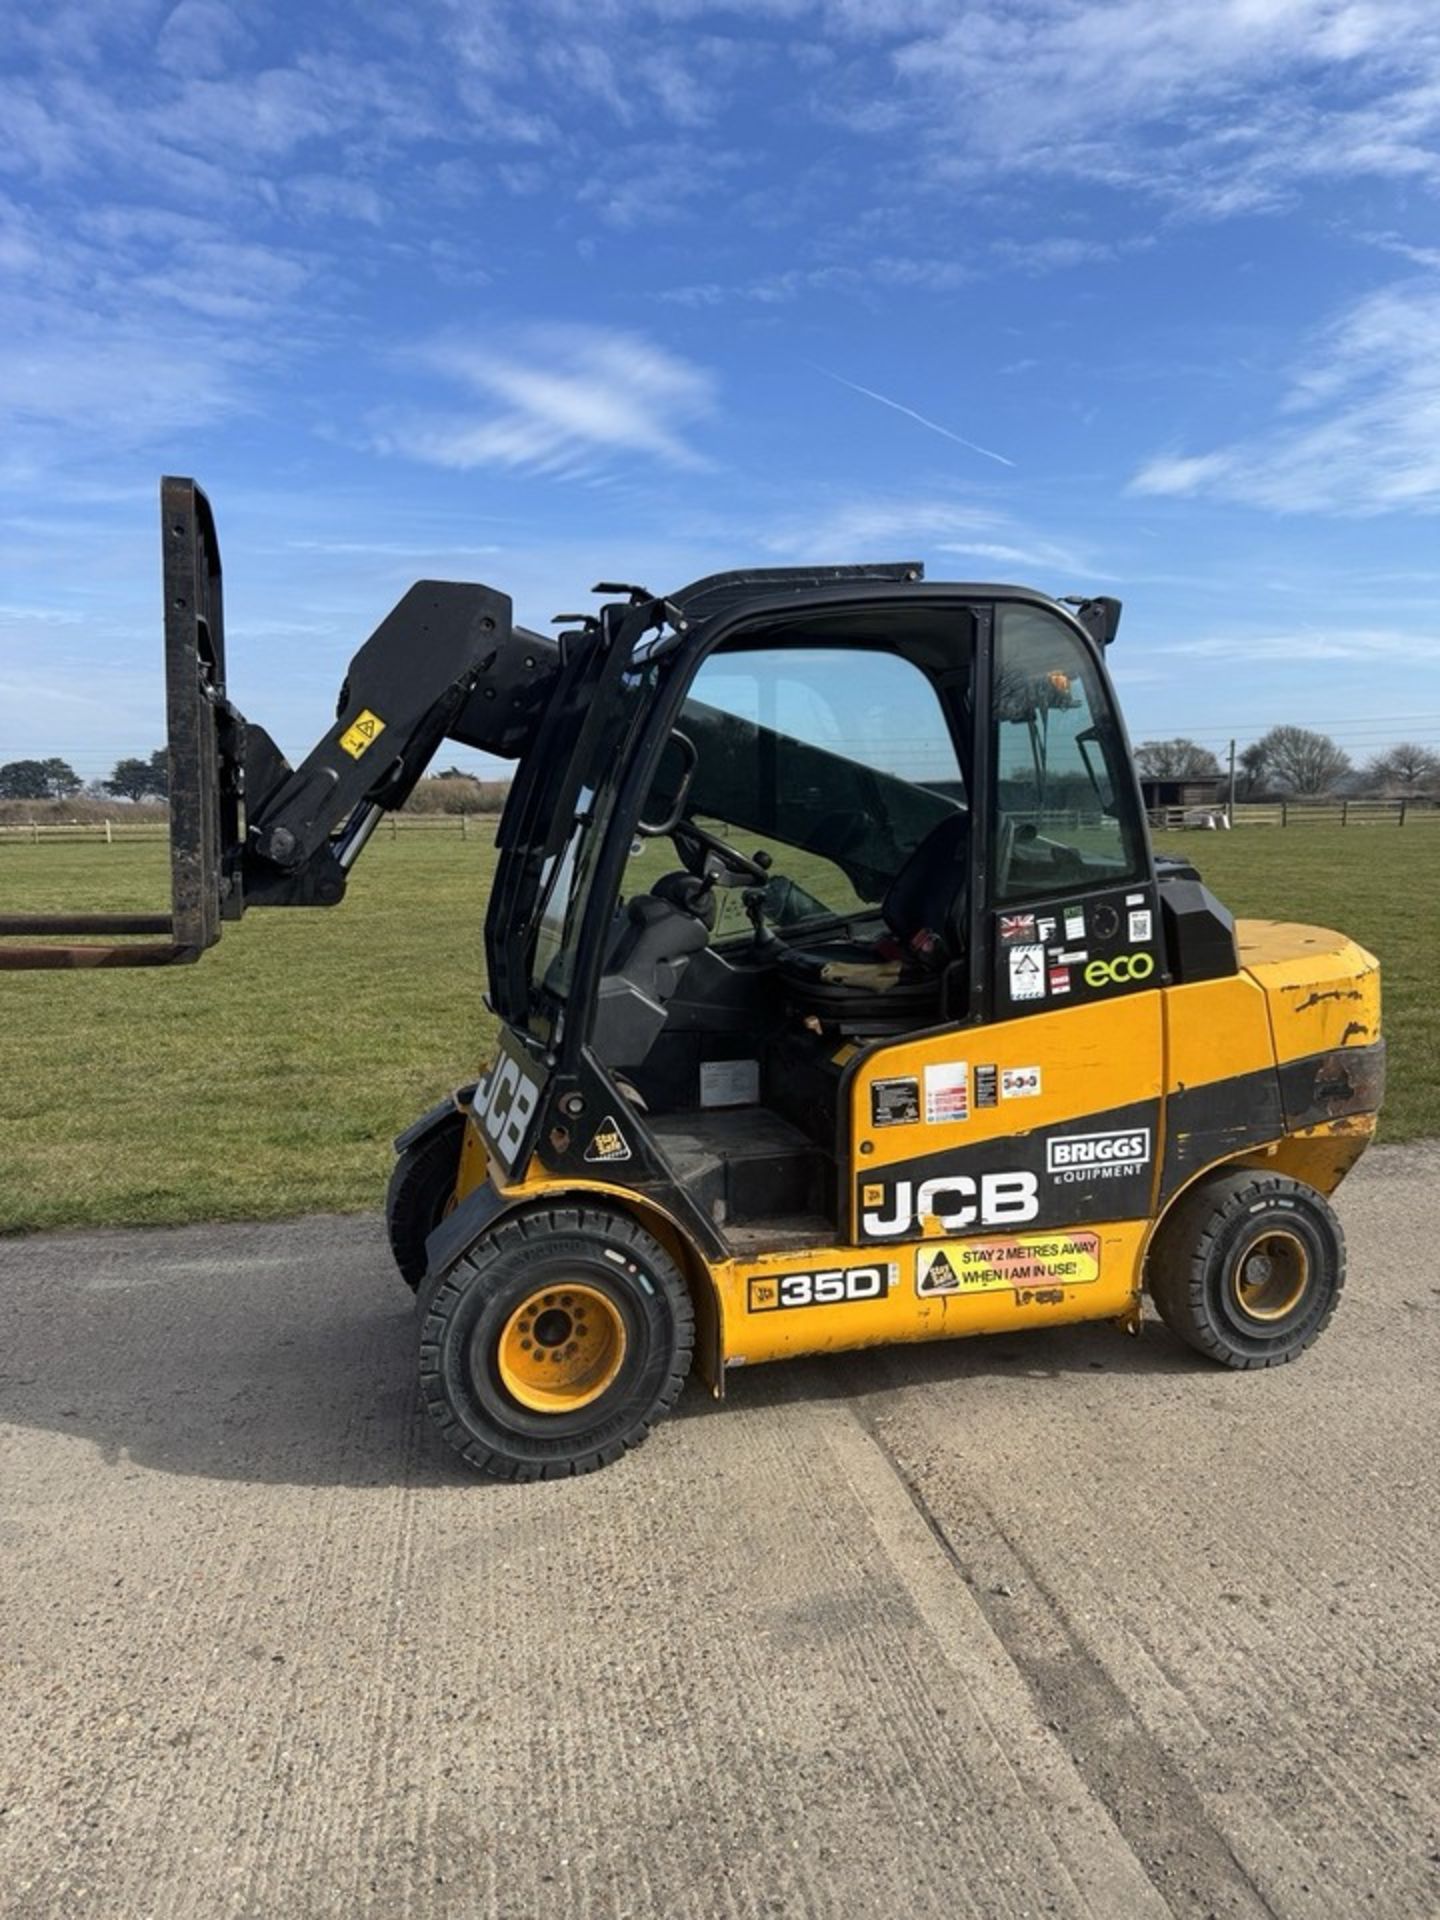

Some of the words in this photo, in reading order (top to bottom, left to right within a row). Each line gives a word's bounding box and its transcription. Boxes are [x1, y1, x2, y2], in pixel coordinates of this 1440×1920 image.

[1084, 952, 1154, 987] eco
[473, 1050, 539, 1165] JCB
[1053, 1136, 1143, 1165] BRIGGS
[1053, 1163, 1143, 1185] EQUIPMENT
[863, 1171, 1039, 1236] JCB
[962, 1249, 994, 1264] STAY
[997, 1248, 1004, 1260] 2
[1006, 1244, 1059, 1259] METRES
[1061, 1241, 1097, 1254] AWAY
[781, 1268, 881, 1306] 35D
[962, 1269, 1003, 1283] WHEN
[1010, 1266, 1031, 1279] AM
[1034, 1265, 1046, 1276] IN
